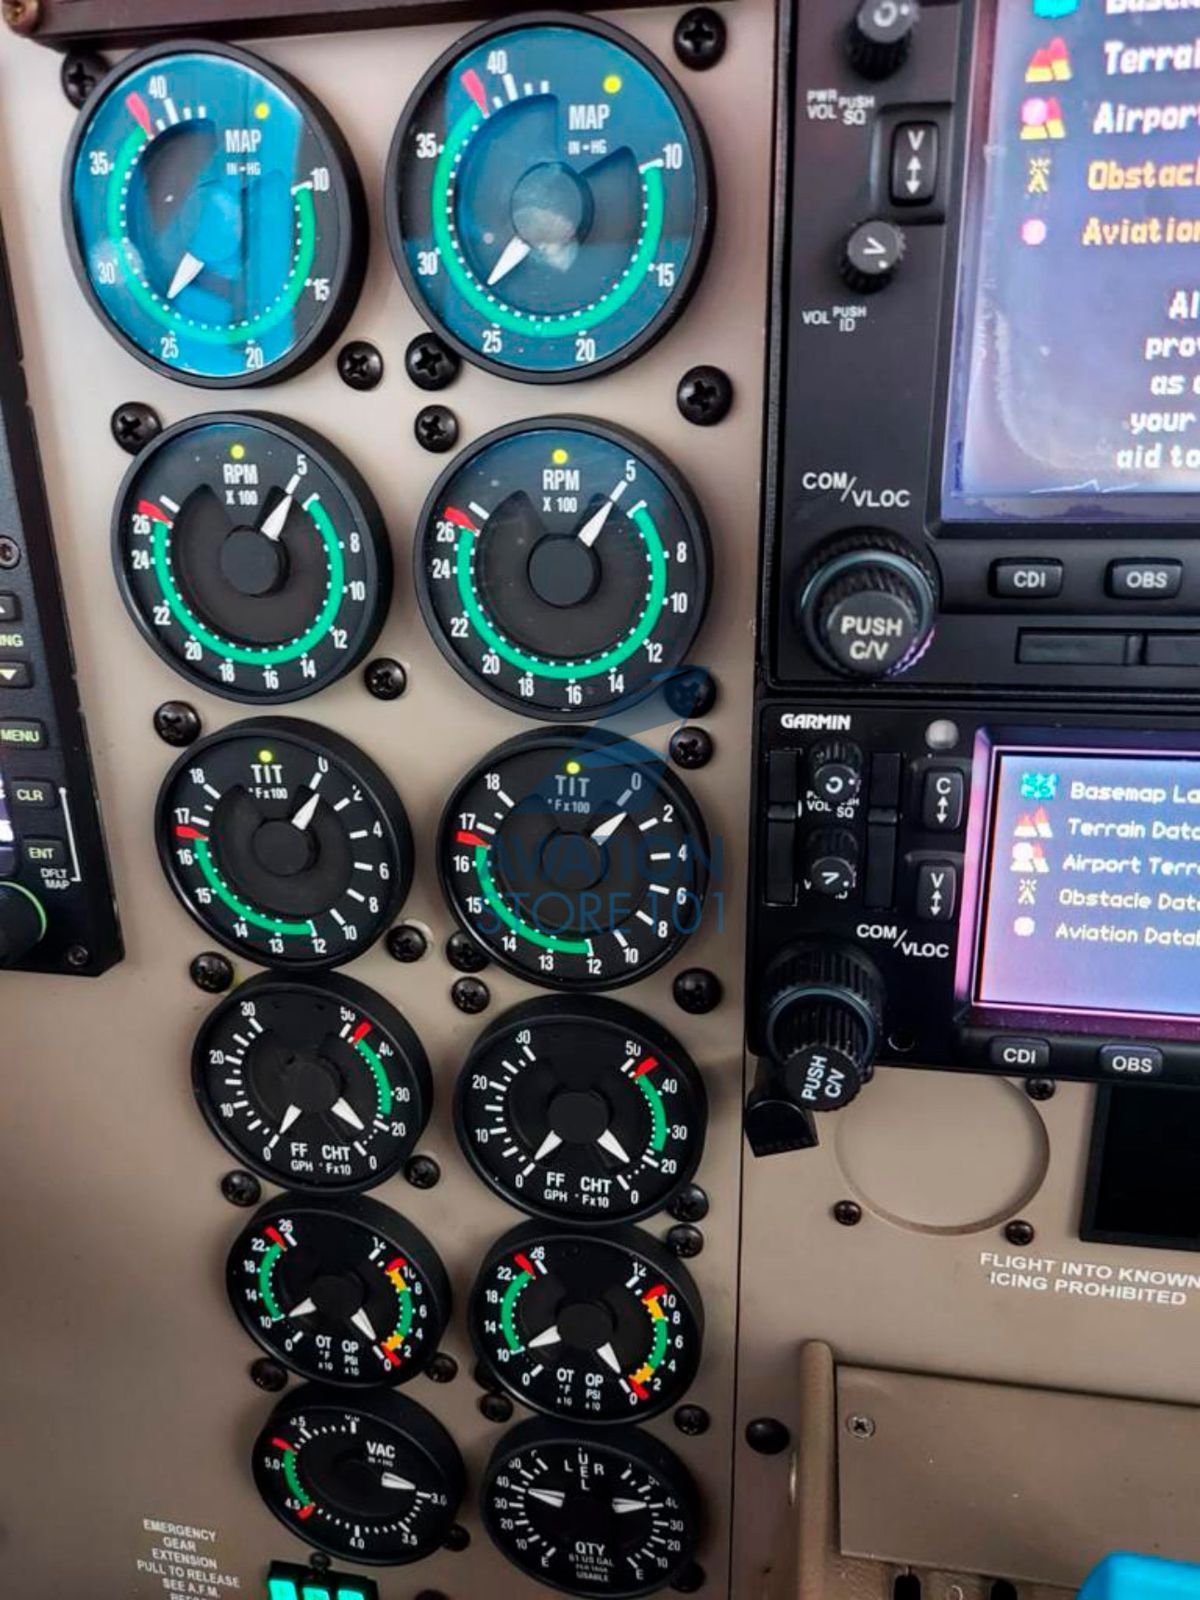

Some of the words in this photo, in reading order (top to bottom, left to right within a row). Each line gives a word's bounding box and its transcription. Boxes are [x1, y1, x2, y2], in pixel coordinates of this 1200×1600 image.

[487, 50, 507, 74] 40
[149, 75, 167, 99] 40
[807, 89, 837, 102] PWR
[838, 96, 875, 109] PUSH
[569, 105, 610, 130] MAP
[807, 104, 837, 120] VOL
[842, 109, 867, 125] SQ
[225, 129, 261, 153] MAP
[416, 133, 437, 158] 35
[90, 152, 109, 175] 35
[663, 144, 683, 169] 10
[311, 168, 330, 191] 10
[418, 252, 438, 274] 30
[99, 263, 114, 284] 30
[656, 264, 675, 287] 15
[313, 279, 330, 301] 15
[802, 310, 830, 325] VOL
[833, 306, 867, 318] PUSH
[839, 319, 856, 332] ID
[161, 337, 178, 359] 25
[482, 331, 502, 353] 25
[576, 339, 595, 362] 20
[246, 347, 263, 368] 20
[1151, 374, 1186, 395] as
[1130, 412, 1196, 435] your
[1116, 443, 1163, 468] aid
[1171, 445, 1200, 468] to
[223, 464, 258, 484] RPM
[543, 470, 580, 490] RPM
[626, 460, 636, 482] 5
[238, 490, 257, 505] 100
[557, 497, 577, 513] 100
[132, 514, 150, 534] 26
[436, 522, 455, 542] 26
[132, 551, 150, 569] 24
[676, 542, 687, 562] 8
[432, 558, 450, 578] 24
[1013, 570, 1046, 589] CDI
[1126, 570, 1168, 590] OBS
[350, 581, 365, 600] 10
[670, 592, 688, 613] 10
[153, 607, 171, 625] 22
[451, 618, 468, 638] 22
[841, 616, 903, 637] PUSH
[332, 630, 347, 649] 12
[185, 642, 202, 660] 20
[647, 643, 662, 662] 12
[849, 641, 890, 661] C/V
[219, 664, 235, 682] 18
[300, 659, 316, 678] 14
[482, 656, 500, 674] 20
[263, 670, 278, 689] 16
[518, 678, 534, 696] 18
[608, 674, 624, 693] 14
[566, 686, 582, 704] 16
[781, 714, 851, 730] GARMIN
[0, 729, 39, 742] MENU
[189, 768, 205, 784] 18
[251, 764, 283, 784] TIT
[485, 774, 500, 791] 18
[16, 789, 43, 801] CLR
[555, 775, 590, 797] TIT
[1070, 781, 1167, 804] Basemap
[806, 801, 831, 812] VOL
[837, 806, 854, 819] SQ
[175, 808, 190, 824] 17
[459, 813, 476, 830] 17
[1068, 817, 1146, 839] Terrain
[28, 847, 55, 859] ENT
[177, 849, 193, 866] 16
[453, 856, 470, 873] 16
[1062, 854, 1142, 874] Airport
[44, 879, 70, 889] MAP
[195, 888, 212, 904] 15
[1059, 888, 1152, 909] Obstacle
[466, 897, 482, 914] 15
[233, 923, 248, 937] 14
[343, 925, 357, 940] 10
[1055, 923, 1138, 942] Aviation
[269, 939, 284, 953] 13
[312, 938, 326, 953] 12
[502, 937, 517, 952] 14
[539, 955, 554, 970] 13
[624, 948, 638, 964] 10
[587, 958, 602, 974] 12
[240, 1001, 256, 1016] 30
[515, 1029, 531, 1044] 30
[209, 1050, 224, 1065] 20
[1002, 1047, 1036, 1065] CDI
[1112, 1055, 1153, 1074] OBS
[472, 1074, 488, 1090] 20
[661, 1078, 678, 1094] 40
[801, 1054, 828, 1100] PUSH
[824, 1068, 845, 1098] C/V
[395, 1087, 410, 1102] 30
[221, 1102, 234, 1118] 10
[391, 1121, 406, 1136] 20
[475, 1128, 489, 1143] 10
[671, 1125, 687, 1140] 30
[291, 1142, 308, 1158] FF
[322, 1145, 350, 1161] CHT
[661, 1159, 677, 1174] 20
[546, 1172, 565, 1187] FF
[580, 1176, 612, 1192] CHT
[251, 1238, 265, 1251] 22
[497, 1266, 511, 1281] 22
[980, 1252, 1058, 1274] FLIGHT
[1061, 1261, 1113, 1280] INTO
[1118, 1267, 1200, 1289] KNOWN
[485, 1290, 498, 1303] 18
[990, 1271, 1048, 1291] ICING
[1054, 1278, 1188, 1306] PROHIBITED
[662, 1294, 676, 1308] 10
[260, 1316, 271, 1329] 10
[672, 1311, 681, 1324] 8
[484, 1320, 496, 1334] 14
[315, 1335, 332, 1350] OT
[342, 1340, 359, 1354] OP
[675, 1335, 683, 1349] 6
[497, 1348, 510, 1362] 10
[556, 1368, 574, 1383] OT
[585, 1373, 604, 1388] OP
[366, 1440, 396, 1458] VAC
[264, 1457, 280, 1470] 5.0
[143, 1518, 216, 1542] EMERGENCY
[500, 1514, 514, 1529] 20
[163, 1536, 196, 1552] GEAR
[350, 1537, 365, 1550] 4.0
[402, 1532, 418, 1546] 3.5
[515, 1539, 528, 1550] 10
[575, 1541, 605, 1556] QTY
[152, 1548, 217, 1570] EXTENSION
[137, 1559, 166, 1575] PULL
[169, 1566, 184, 1577] TO
[187, 1568, 240, 1588] RELEASE
[162, 1578, 185, 1592] SEE
